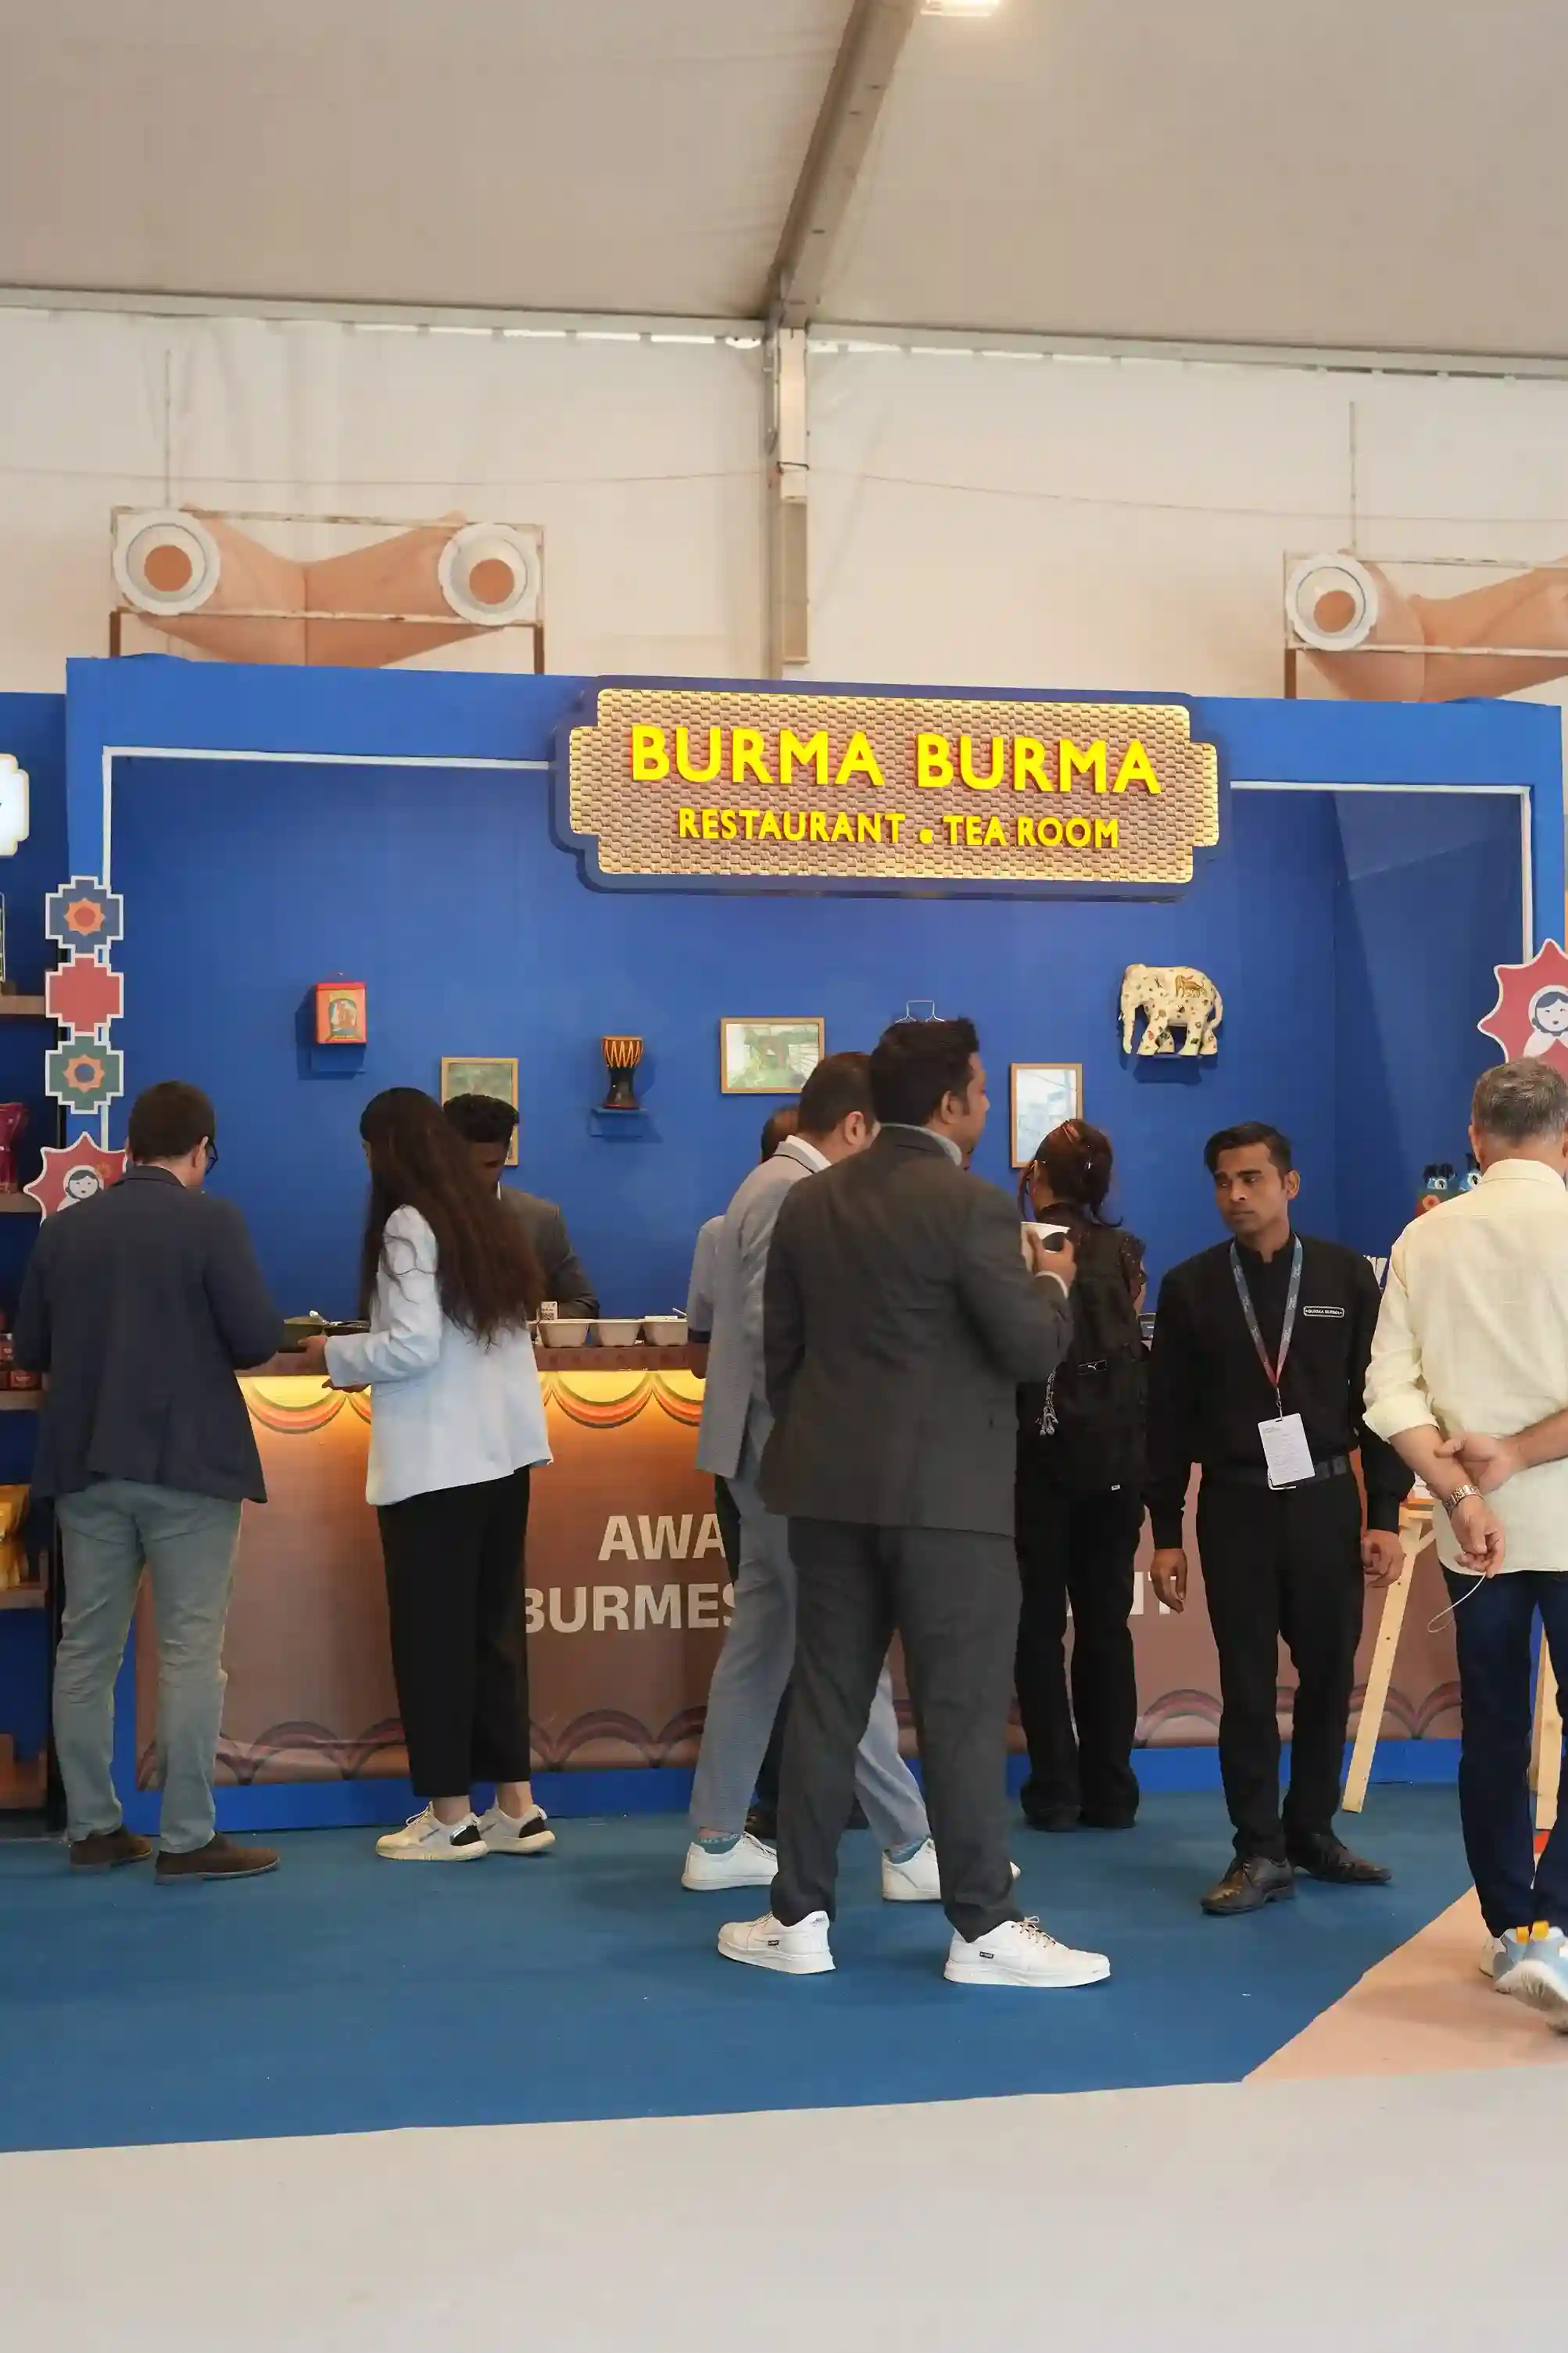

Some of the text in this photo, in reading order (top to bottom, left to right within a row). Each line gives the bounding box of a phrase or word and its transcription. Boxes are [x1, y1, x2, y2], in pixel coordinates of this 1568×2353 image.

[632, 724, 1162, 793] BURMA BURMA
[678, 807, 1119, 848] RESTAURANT TEA ROOM
[598, 1513, 725, 1561] AWA
